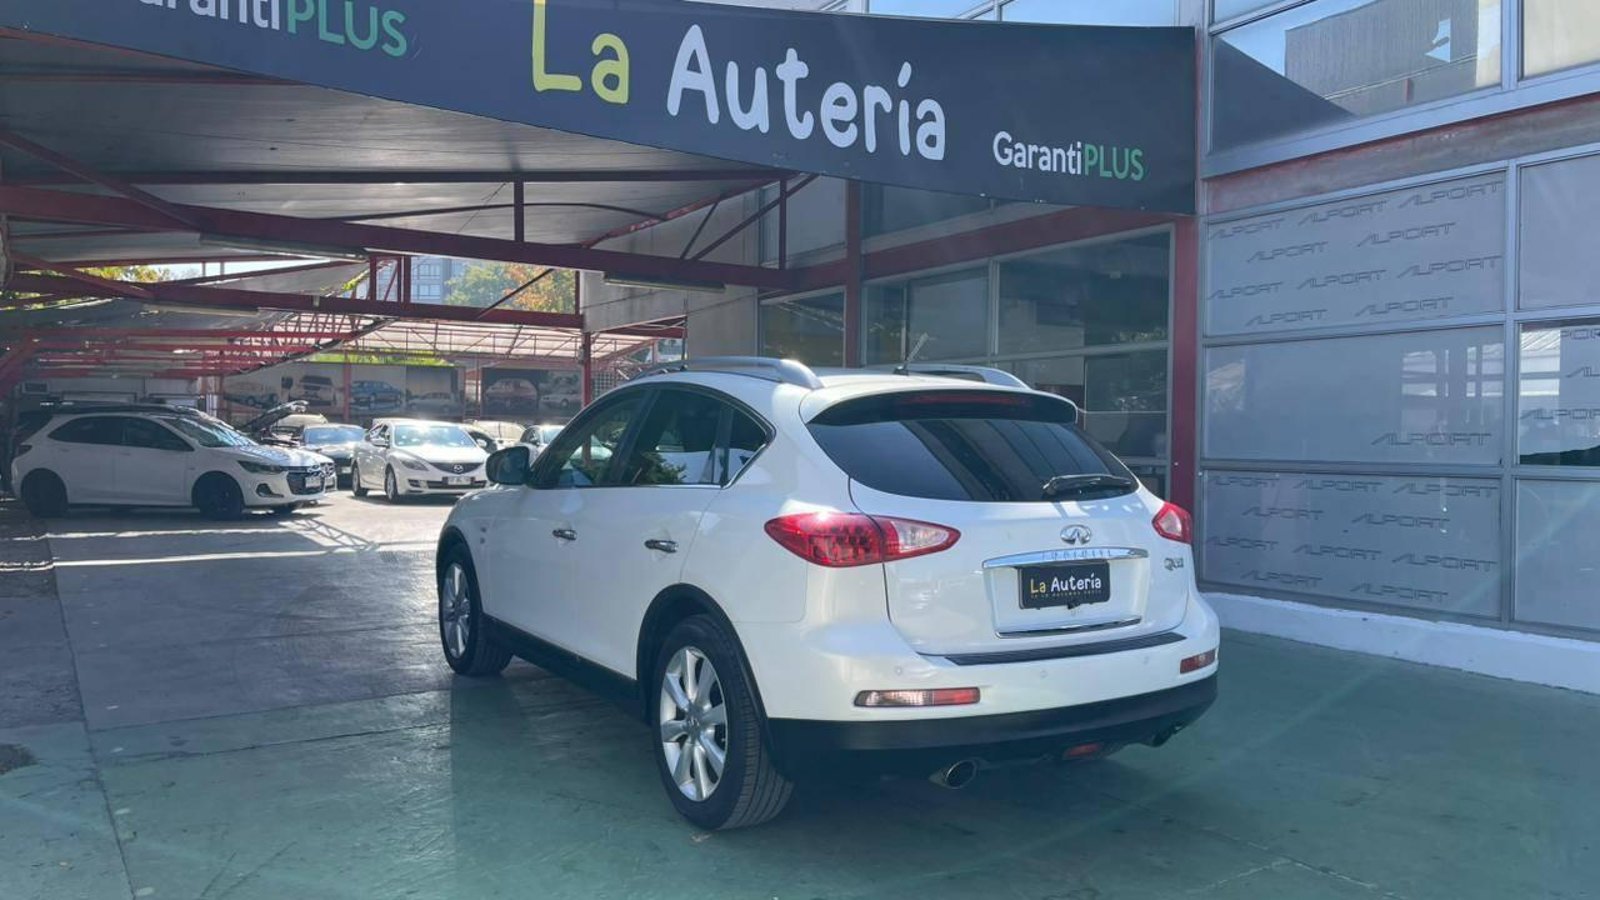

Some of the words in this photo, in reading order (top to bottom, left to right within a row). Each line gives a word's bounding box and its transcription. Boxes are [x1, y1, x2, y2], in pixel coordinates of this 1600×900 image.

[137, 0, 408, 57] antiPLUS
[531, 0, 630, 104] La
[666, 23, 946, 161] Autería
[993, 130, 1144, 181] GarantiPLUS
[1298, 200, 1388, 225] ALPORT
[1398, 181, 1504, 209] ALPORT
[1246, 241, 1329, 262] ALPORT
[1357, 222, 1457, 248] ALPORT
[1297, 270, 1387, 290] ALPORT
[1396, 255, 1503, 279] ALPORT
[1244, 309, 1329, 326] ALPORT
[1354, 297, 1455, 317] ALPORT
[1370, 432, 1492, 446] ALPORT
[1393, 482, 1499, 498] ALPORT
[1352, 513, 1450, 528] ALPORT
[1291, 543, 1382, 560] ALPORT
[1392, 553, 1498, 573] ALPORT
[1030, 578, 1046, 594] La
[1050, 572, 1102, 592] Autería
